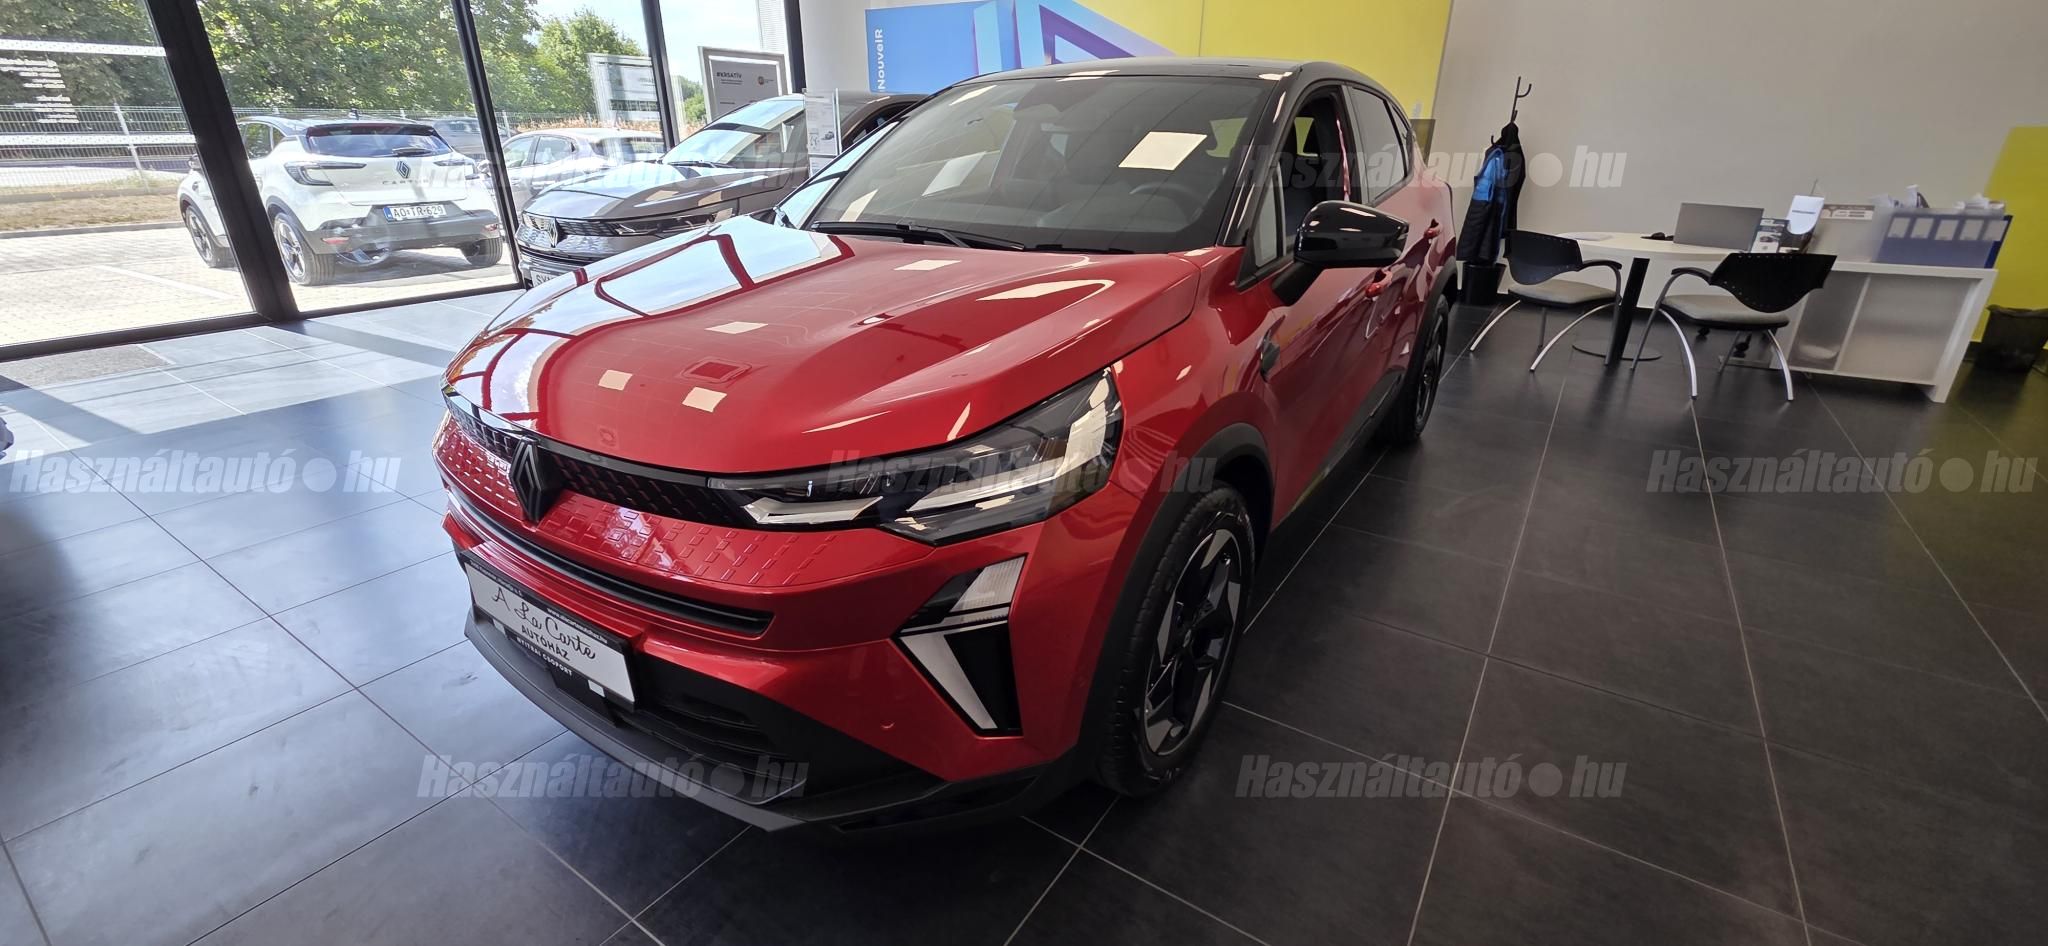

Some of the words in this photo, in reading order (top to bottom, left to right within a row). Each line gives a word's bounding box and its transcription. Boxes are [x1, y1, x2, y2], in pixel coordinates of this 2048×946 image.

[492, 586, 510, 611] A
[514, 602, 542, 630] La
[545, 616, 596, 660] Carte
